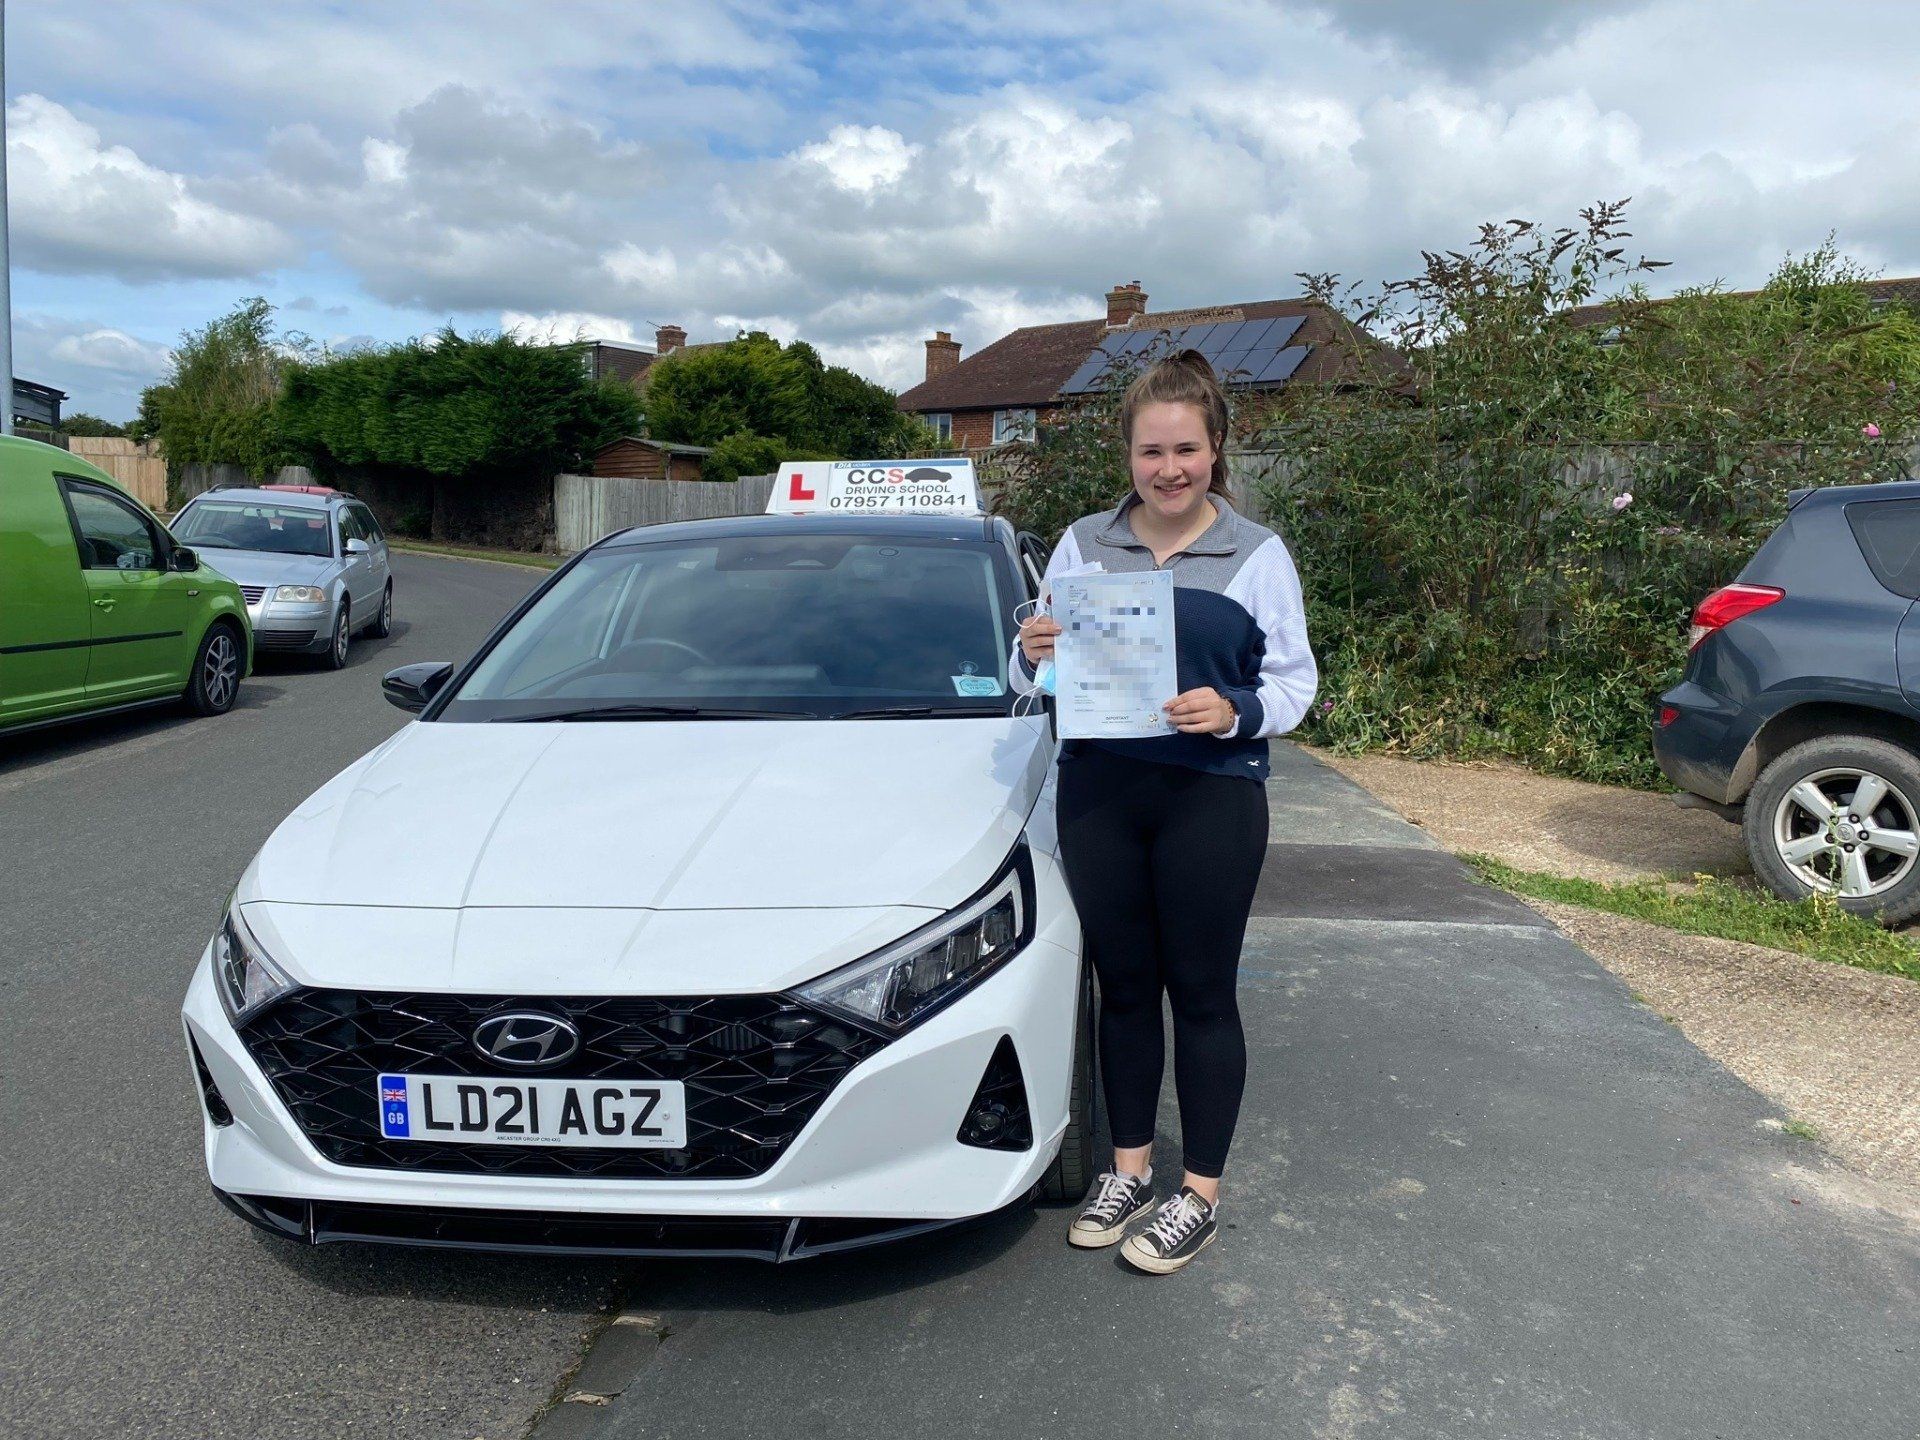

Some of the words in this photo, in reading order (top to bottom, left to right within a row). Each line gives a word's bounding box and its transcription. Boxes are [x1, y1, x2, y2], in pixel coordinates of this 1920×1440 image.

[847, 468, 904, 485] CCS
[789, 474, 815, 501] L
[845, 486, 895, 495] DRIVING
[899, 485, 951, 494] SCHOOL
[830, 496, 889, 508] 07957
[896, 495, 966, 507] 110841
[422, 1083, 540, 1134] LD21
[558, 1087, 663, 1137] AGZ
[388, 1113, 404, 1125] GB
